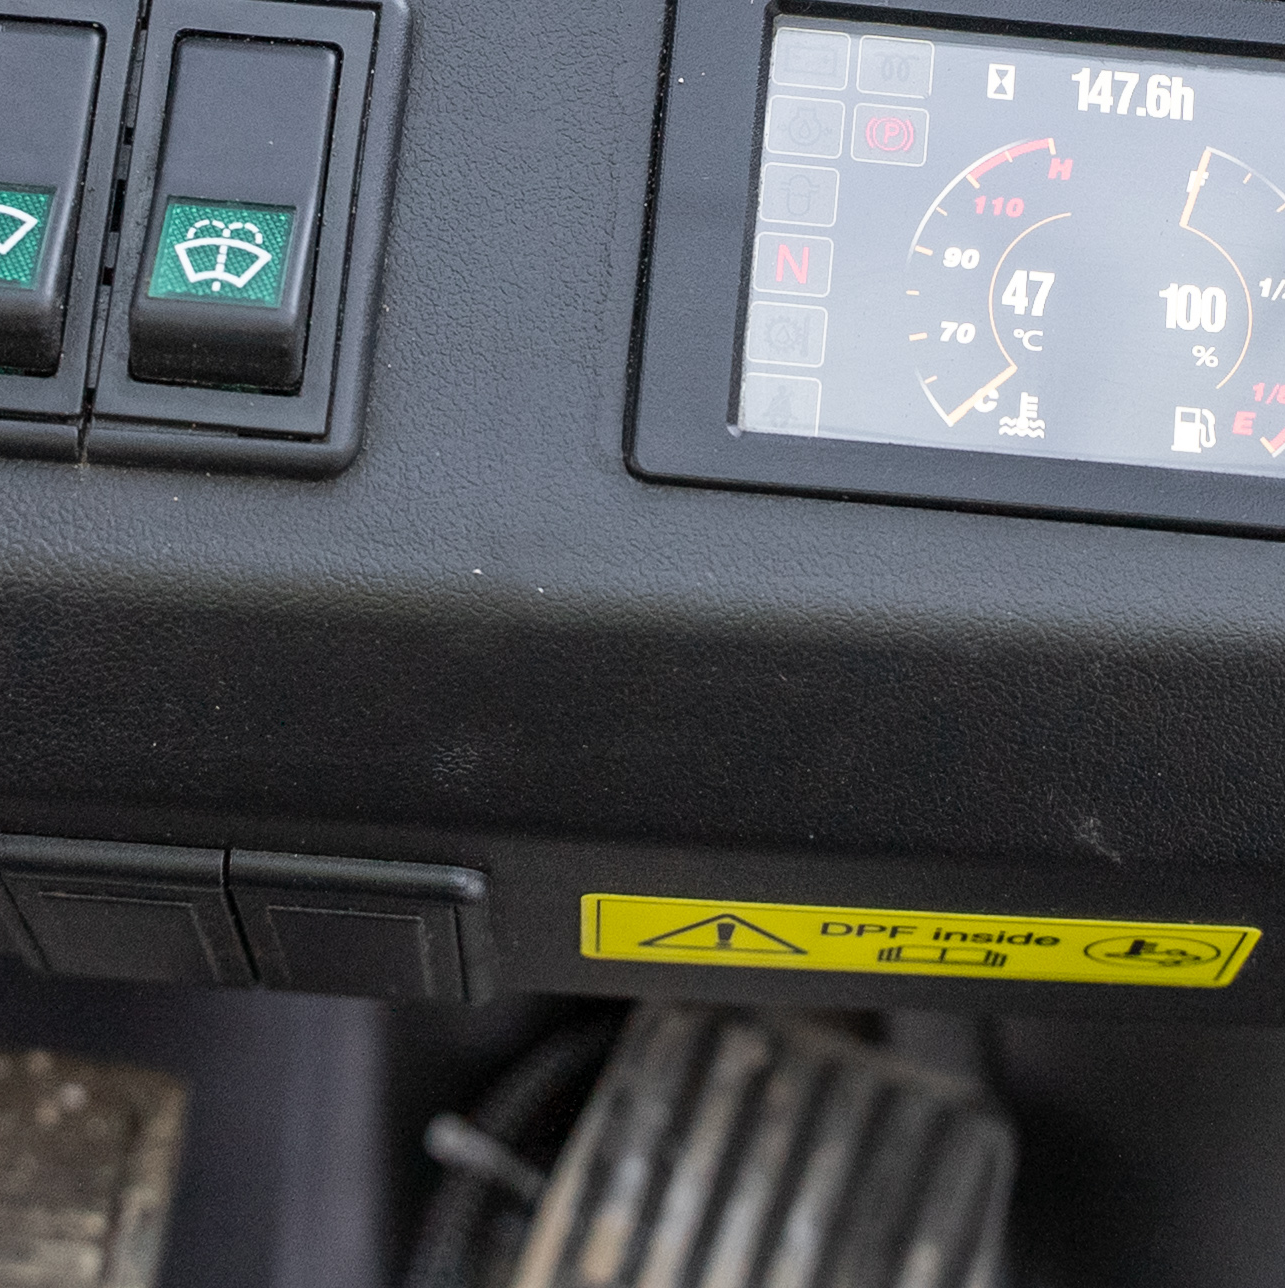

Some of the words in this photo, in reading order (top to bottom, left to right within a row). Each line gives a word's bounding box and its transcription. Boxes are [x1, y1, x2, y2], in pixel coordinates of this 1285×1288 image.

[1071, 67, 1195, 121] 147.6h
[1048, 158, 1073, 180] H
[974, 195, 1024, 217] 110
[775, 244, 809, 284] N
[943, 247, 980, 269] 90
[1001, 270, 1055, 317] 47
[1158, 282, 1228, 333] 100
[940, 321, 976, 344] 70
[1191, 345, 1219, 368] %
[1232, 410, 1257, 436] E
[820, 921, 917, 939] DPF
[932, 927, 1061, 947] inside
